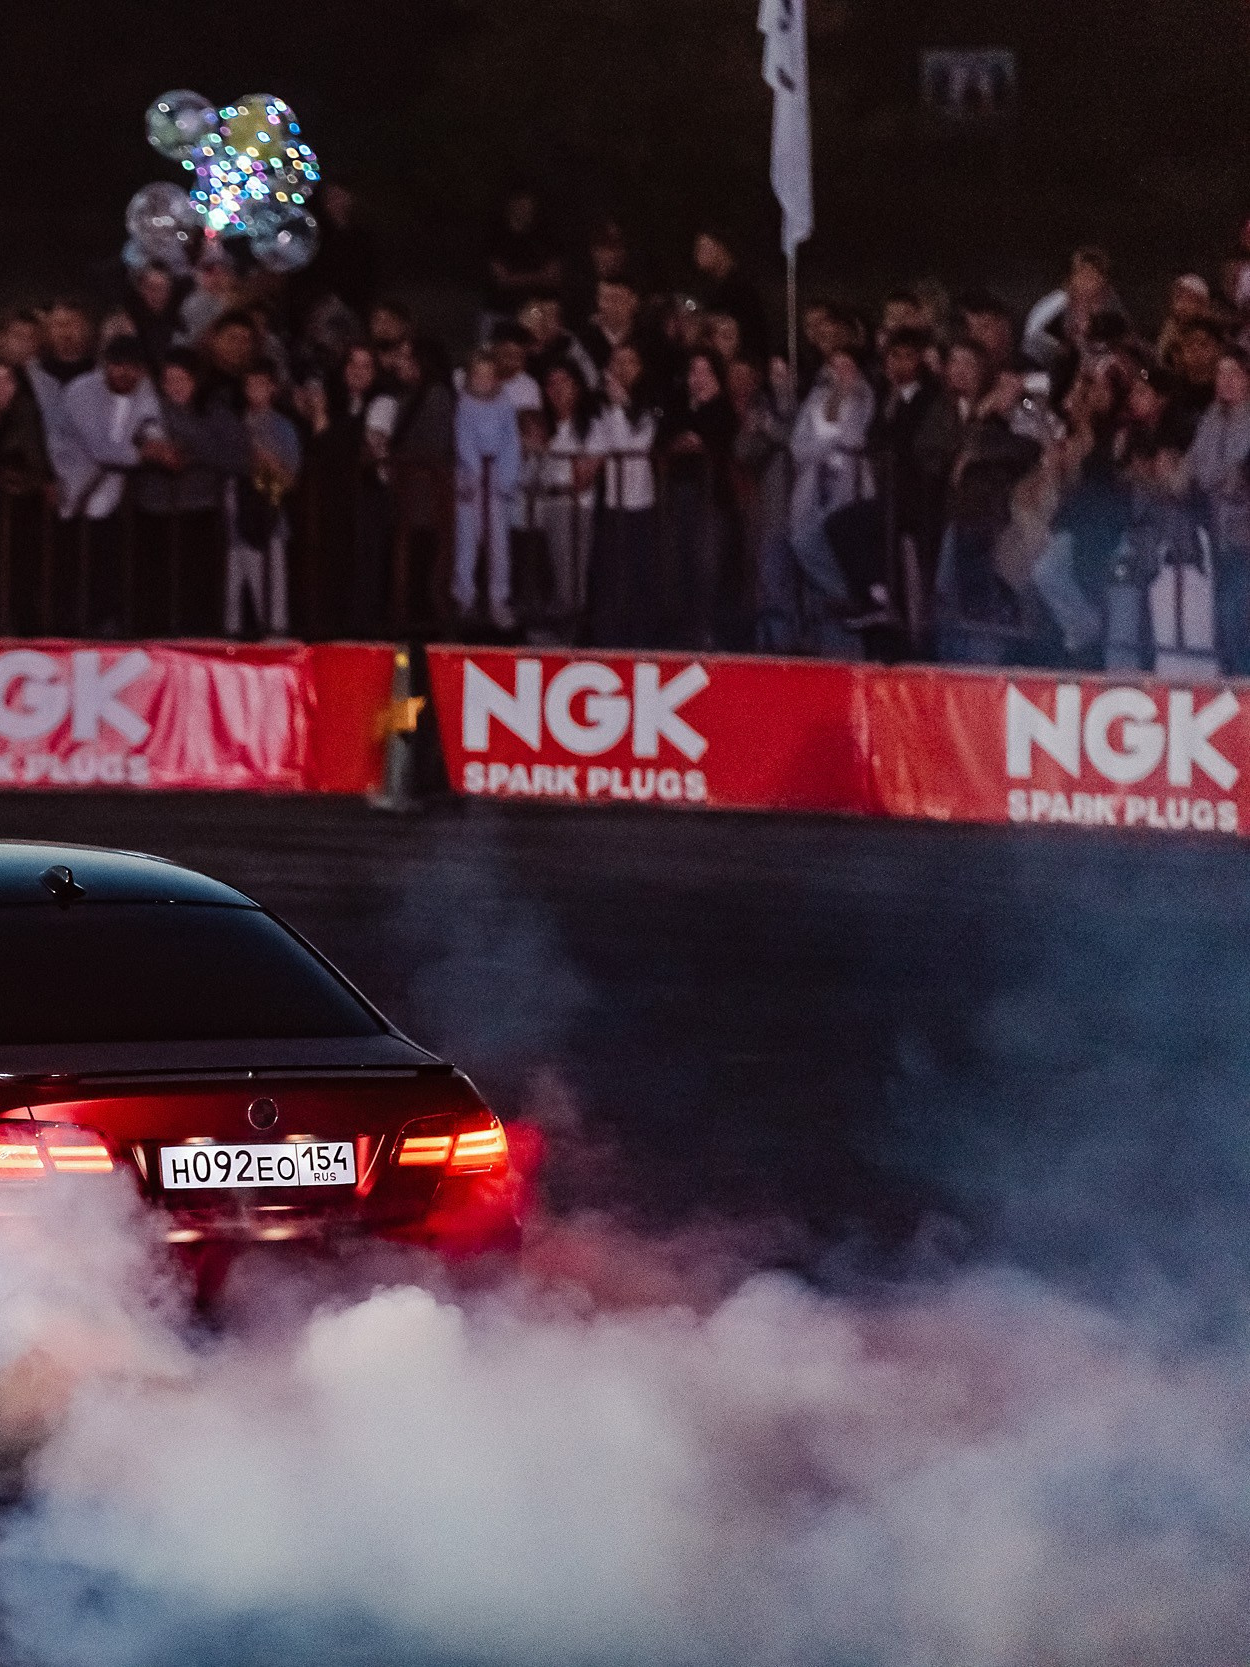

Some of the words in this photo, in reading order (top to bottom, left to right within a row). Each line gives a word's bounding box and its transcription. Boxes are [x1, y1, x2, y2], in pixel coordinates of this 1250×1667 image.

[462, 657, 710, 763] NGK
[1006, 681, 1240, 792] NGK
[463, 761, 579, 798] SPARK
[586, 765, 708, 801] PLUGS
[1007, 789, 1117, 826] SPARK
[1124, 794, 1239, 833] PLUGS
[301, 1145, 348, 1172] 154
[314, 1172, 337, 1182] RUS
